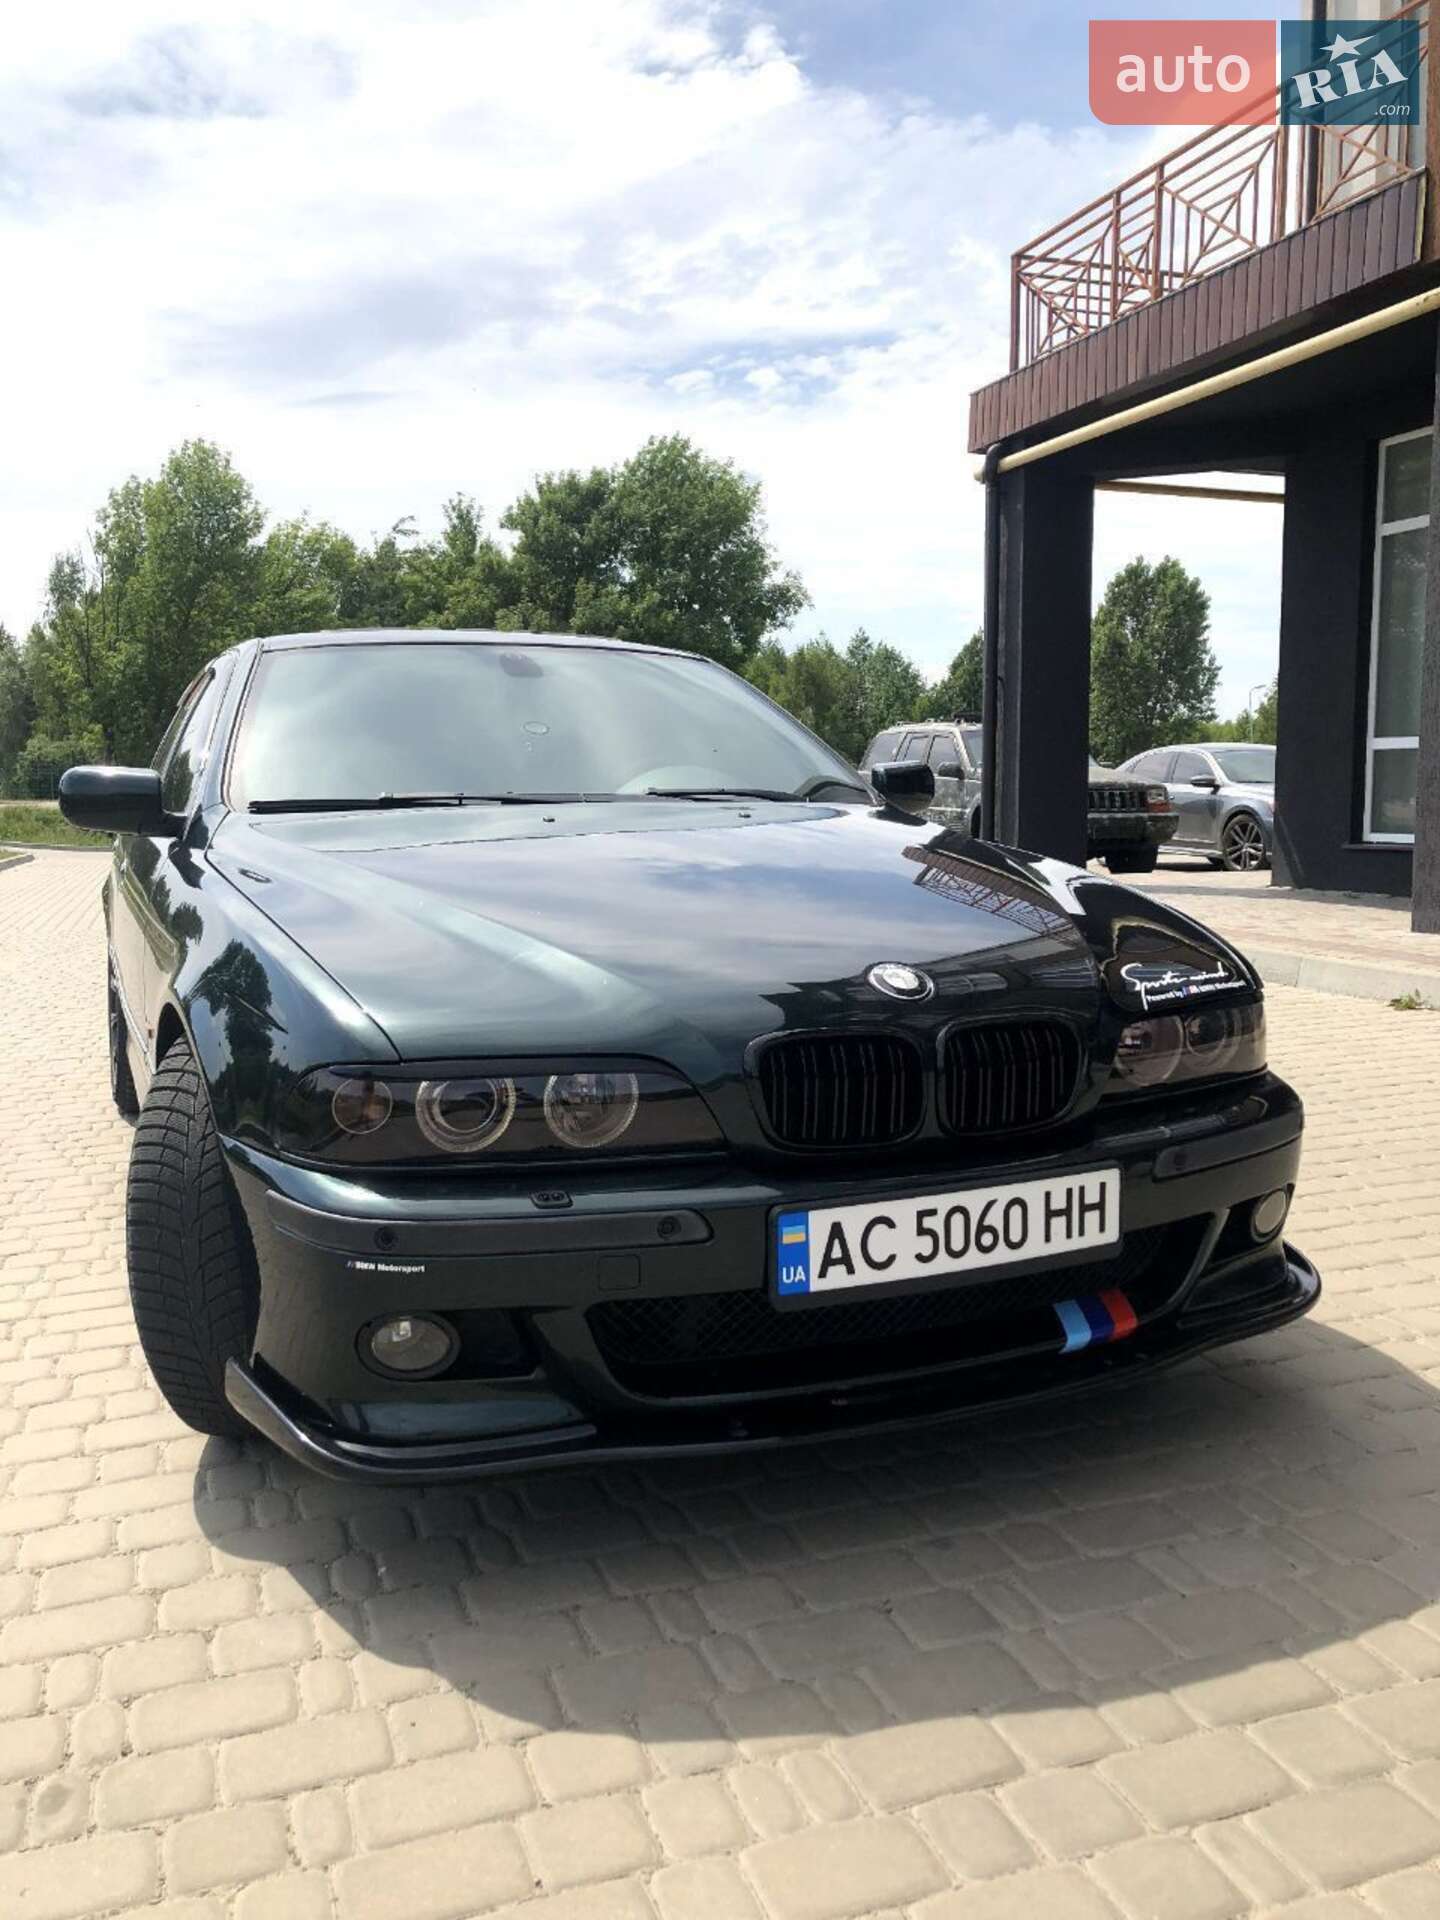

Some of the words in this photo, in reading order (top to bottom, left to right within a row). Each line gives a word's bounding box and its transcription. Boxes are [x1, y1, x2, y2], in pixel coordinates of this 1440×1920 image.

[818, 1216, 896, 1279] AC
[915, 1198, 1028, 1264] 5060
[1044, 1181, 1106, 1244] HH
[782, 1266, 806, 1284] UA
